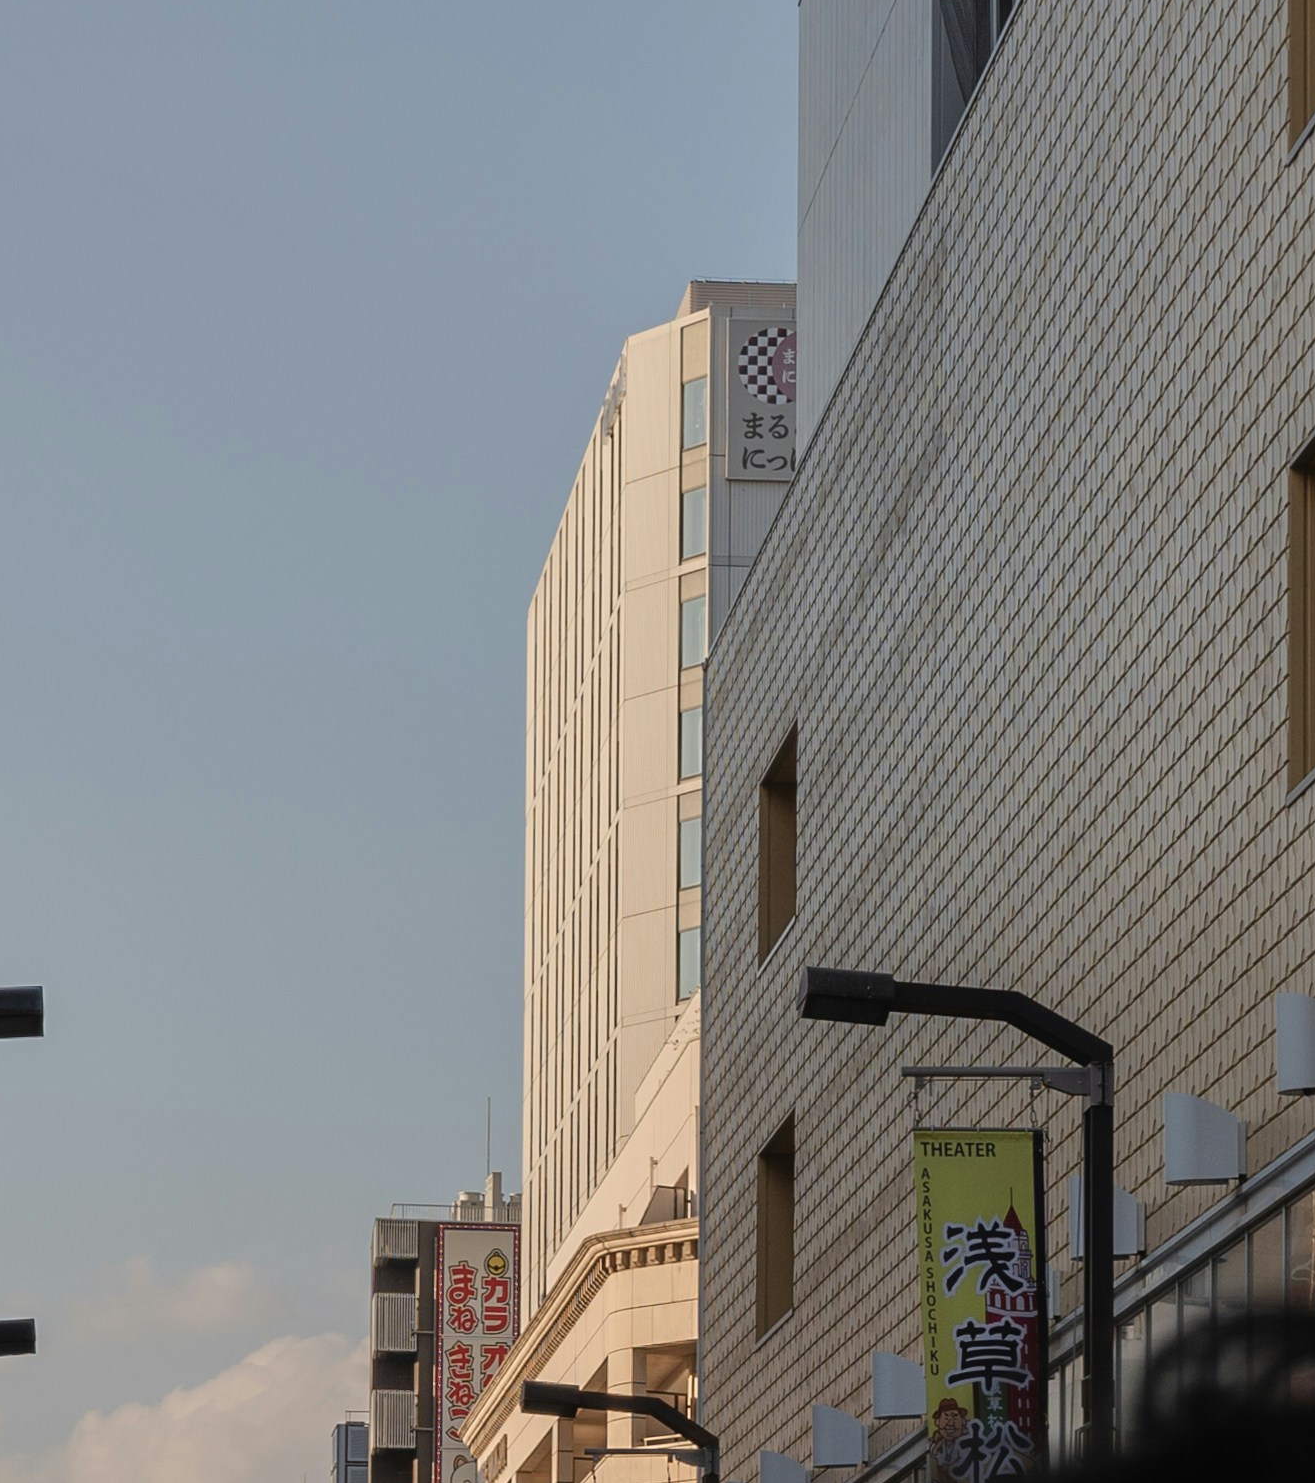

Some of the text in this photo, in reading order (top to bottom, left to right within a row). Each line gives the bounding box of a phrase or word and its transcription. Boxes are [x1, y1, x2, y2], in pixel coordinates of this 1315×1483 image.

[920, 1142, 997, 1158] THEATER
[921, 1168, 940, 1376] ASAKUSA SHOCHIKU
